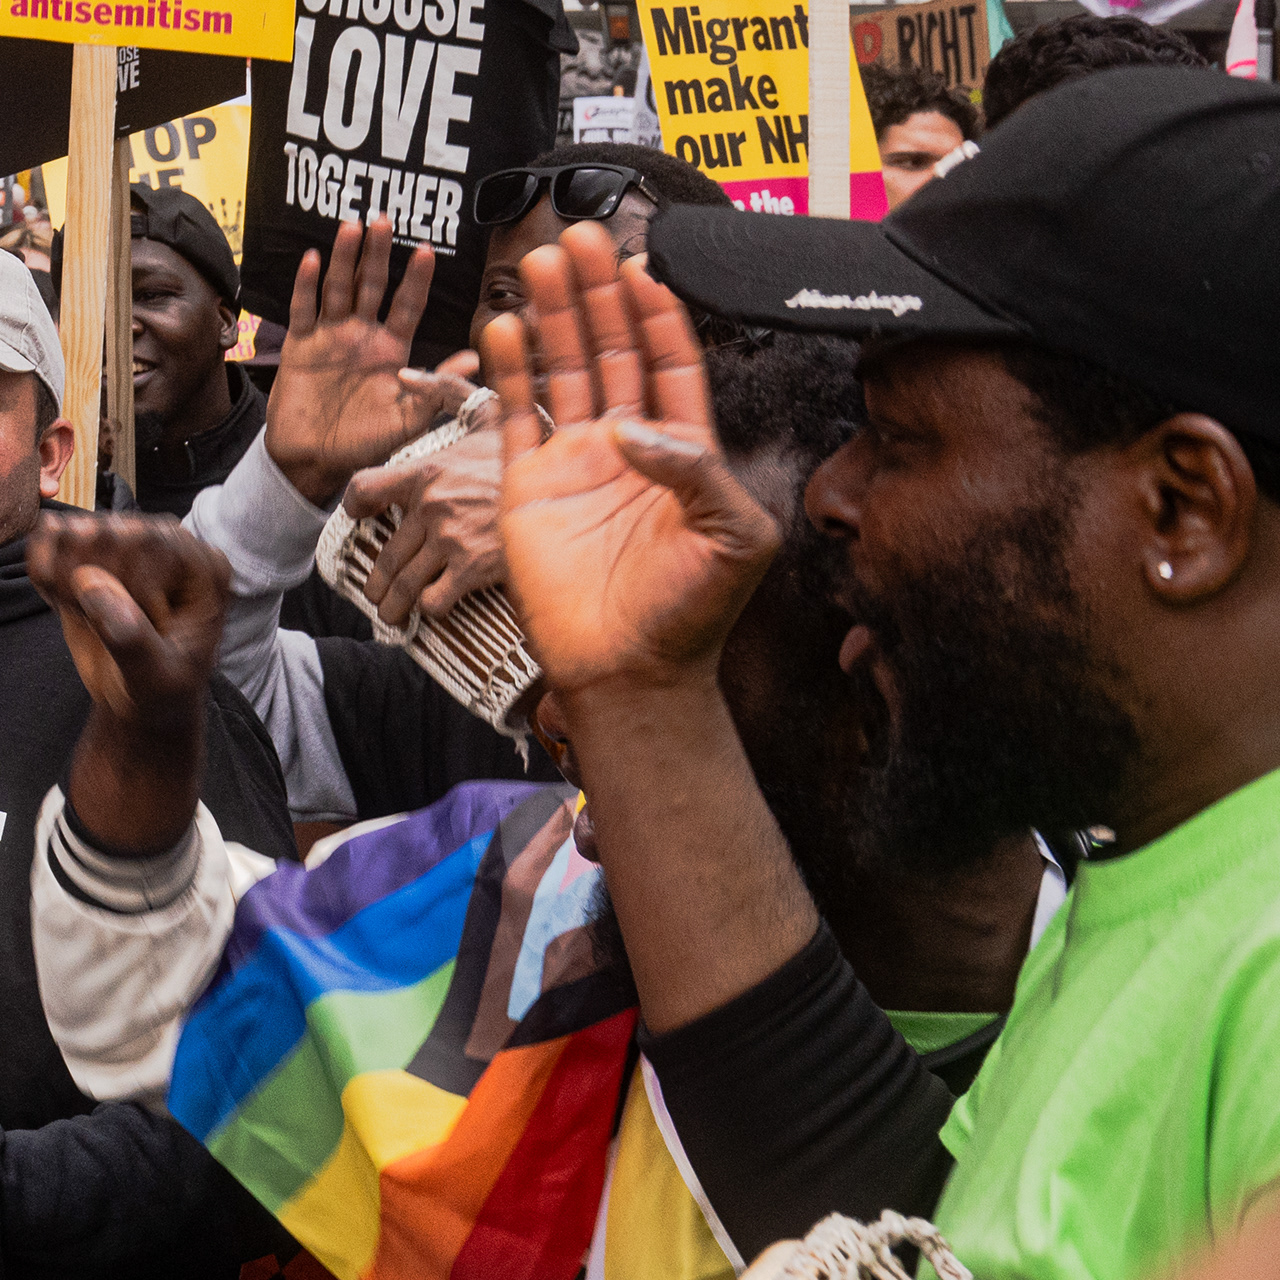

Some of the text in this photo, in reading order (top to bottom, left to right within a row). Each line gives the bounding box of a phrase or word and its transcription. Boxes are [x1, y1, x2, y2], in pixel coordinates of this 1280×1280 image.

[650, 4, 809, 65] Migrant
[286, 16, 482, 173] LOVE
[664, 65, 779, 116] make
[129, 116, 217, 168] OP
[675, 131, 746, 170] our
[284, 141, 463, 246] TOGETHER
[750, 189, 795, 216] the
